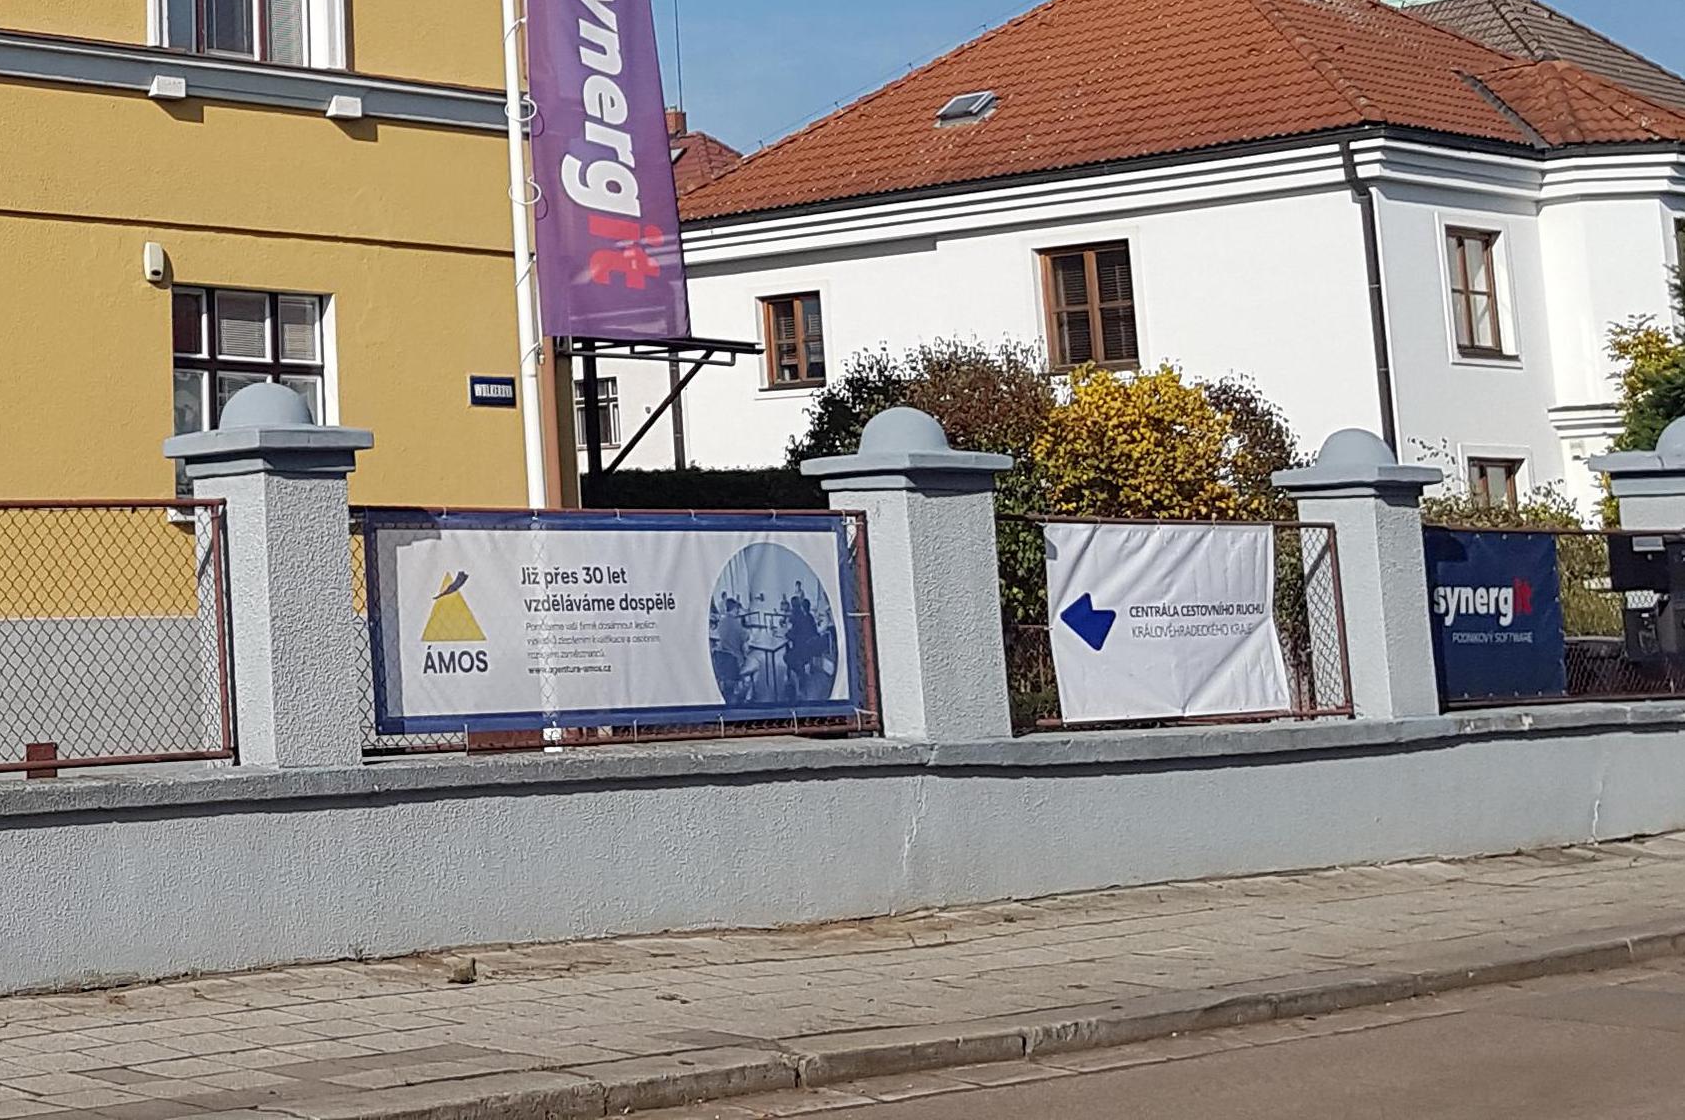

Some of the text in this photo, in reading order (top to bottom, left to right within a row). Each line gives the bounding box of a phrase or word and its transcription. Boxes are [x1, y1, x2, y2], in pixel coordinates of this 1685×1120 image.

[520, 566, 628, 589] Již přes 30 let
[524, 592, 676, 615] vzděláváme dospělé
[1129, 601, 1265, 618] CENTRÁLA CESTOVNÍHO RUCHU
[423, 645, 489, 674] ÁMOS
